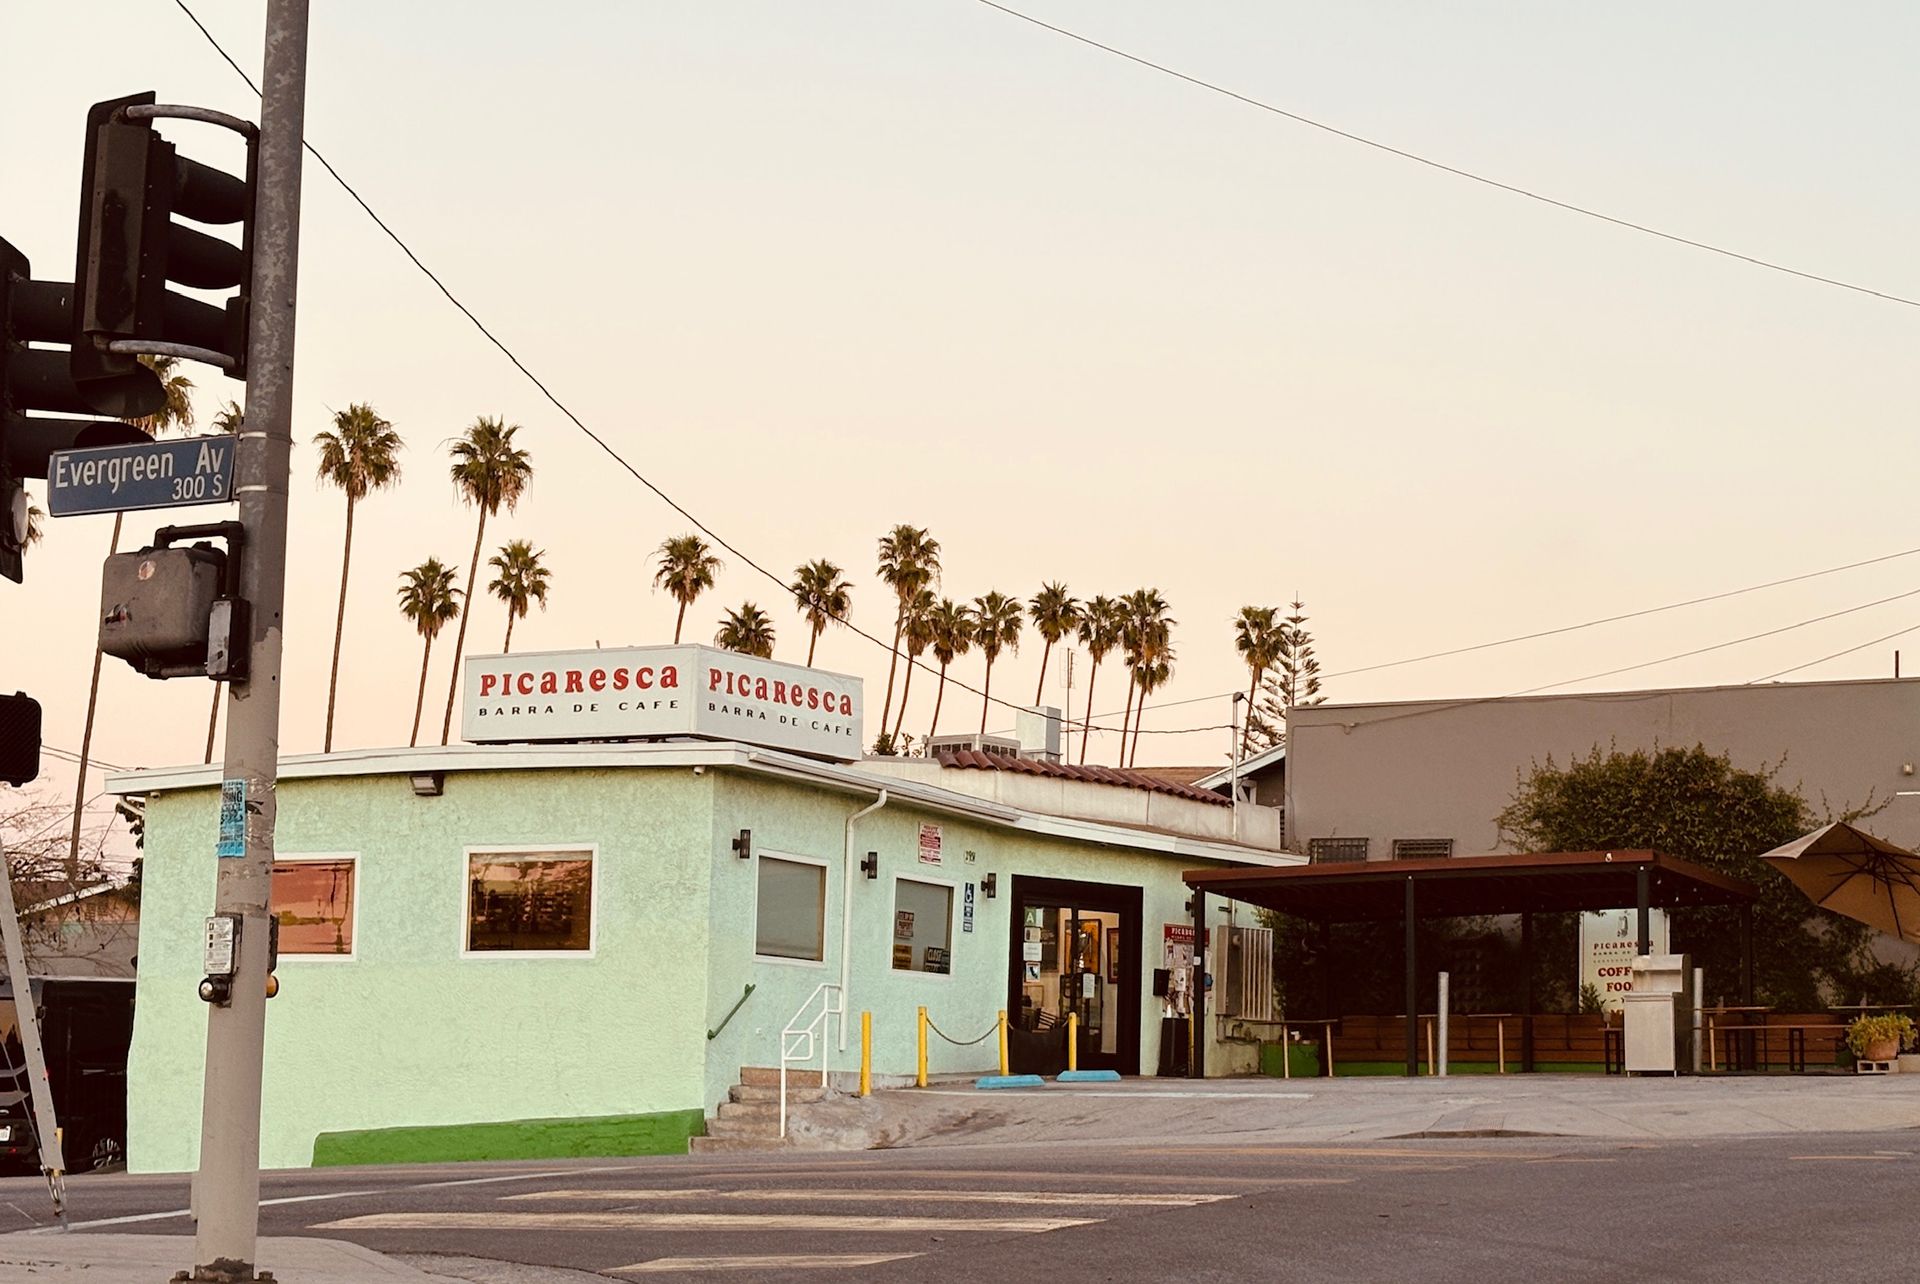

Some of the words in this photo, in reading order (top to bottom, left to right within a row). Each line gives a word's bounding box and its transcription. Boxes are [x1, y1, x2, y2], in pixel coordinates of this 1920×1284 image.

[55, 451, 174, 494] Evergreen
[195, 442, 225, 474] Av
[172, 477, 206, 501] 300
[212, 474, 223, 497] S
[478, 705, 555, 717] BARRA
[573, 703, 599, 714] DE
[618, 699, 680, 711] CAFE
[708, 702, 767, 721] BARRA
[779, 715, 799, 727] DE
[811, 720, 853, 736] CAFE
[1026, 912, 1035, 923] A
[1598, 966, 1632, 977] COFF
[1606, 981, 1633, 992] FOO
